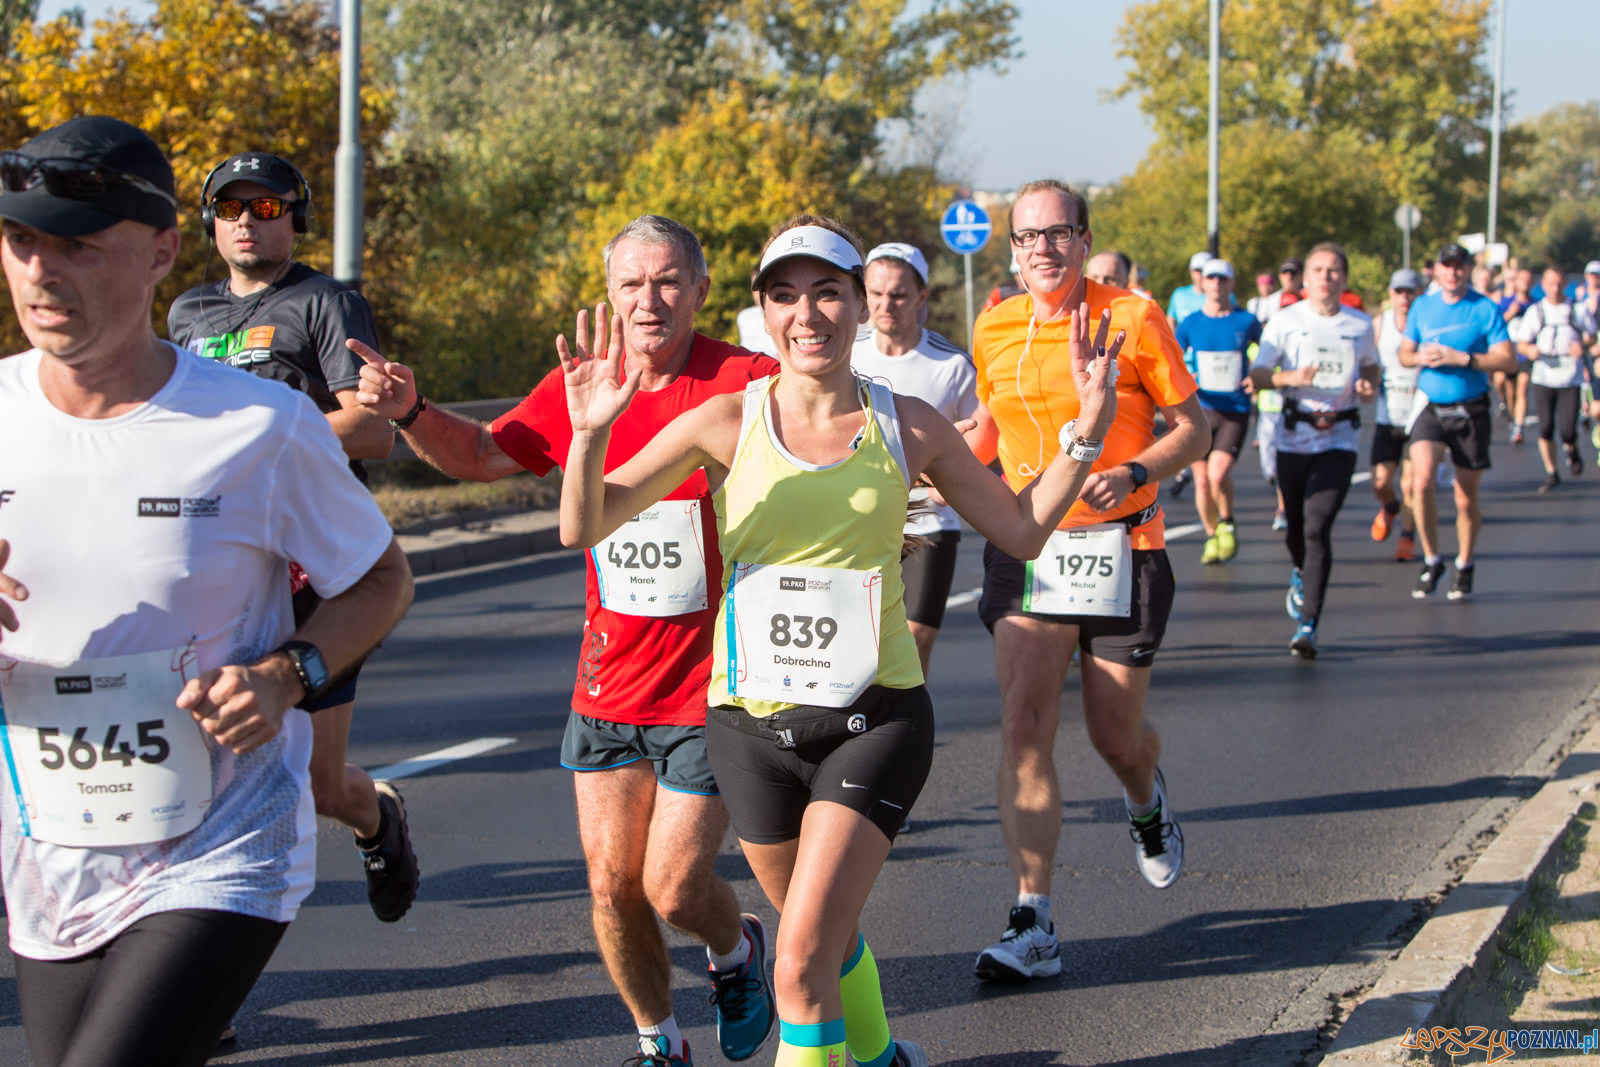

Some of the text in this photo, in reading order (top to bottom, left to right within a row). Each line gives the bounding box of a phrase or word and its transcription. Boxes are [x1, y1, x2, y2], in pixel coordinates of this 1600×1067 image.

[607, 541, 682, 570] 4205
[1055, 554, 1113, 577] 1975
[629, 575, 656, 585] Marek
[769, 613, 838, 650] 839
[773, 654, 831, 669] Dobrochna
[37, 719, 171, 770] 5645
[77, 781, 134, 795] Tomasz
